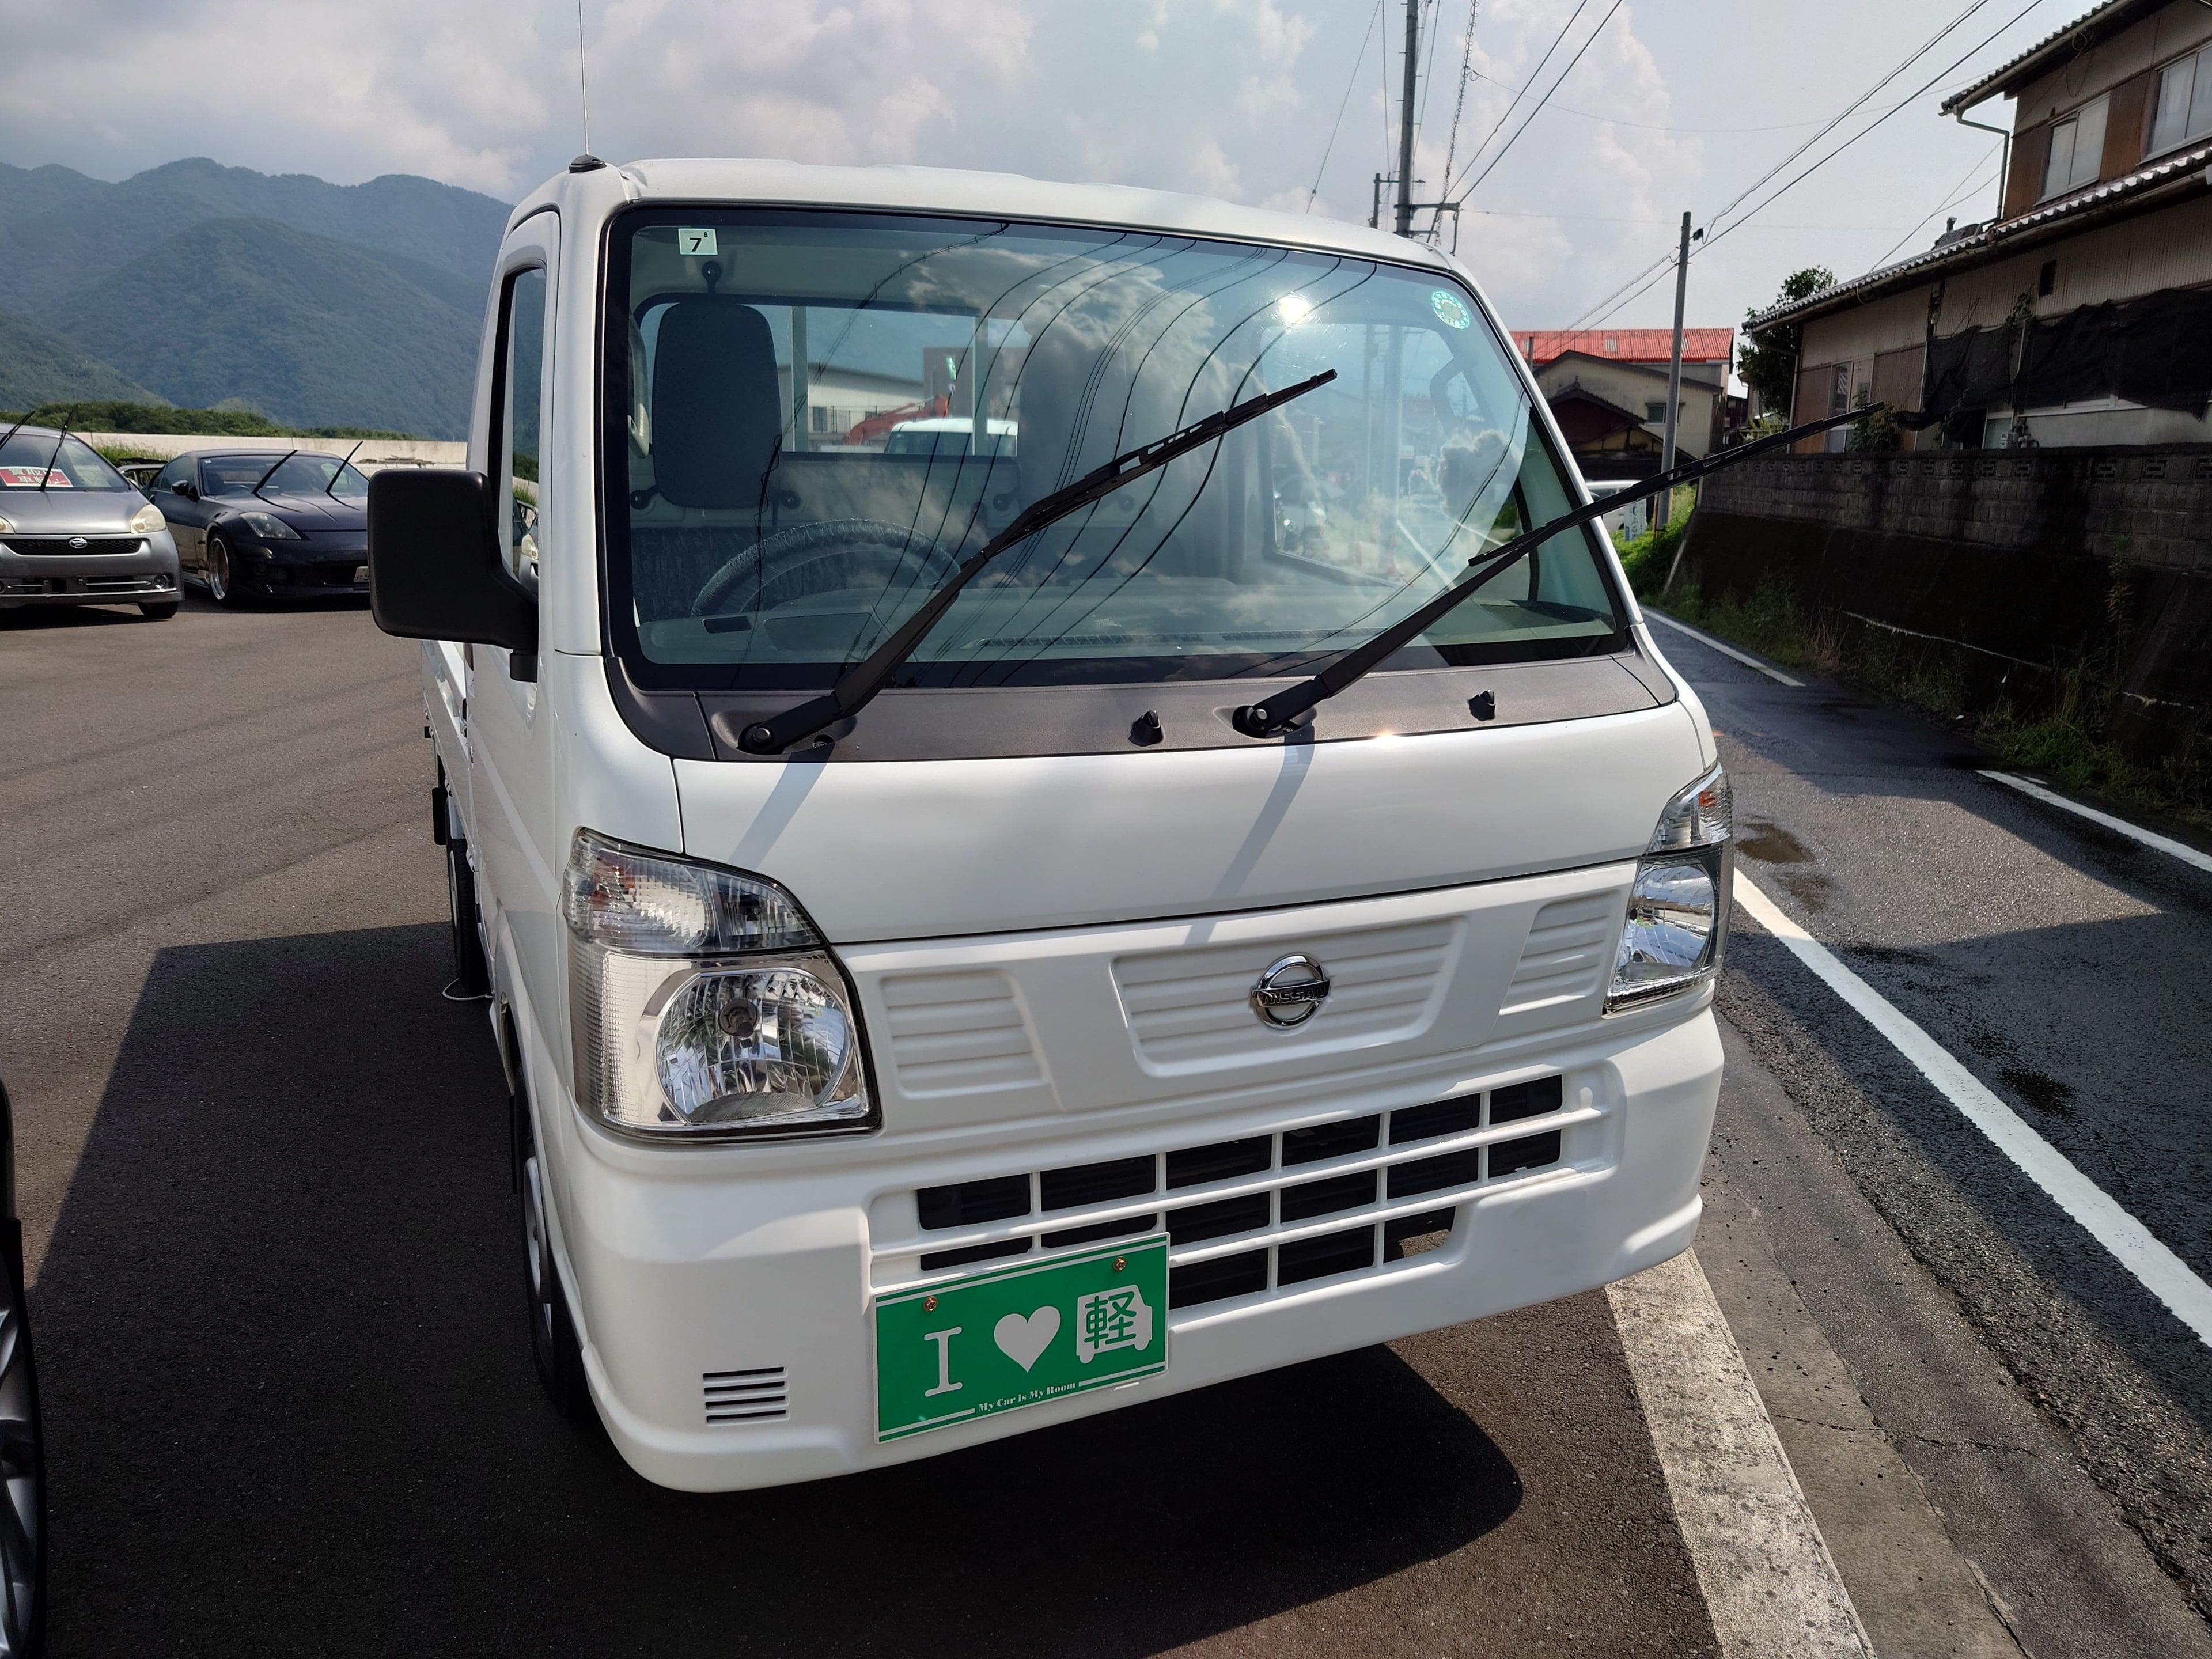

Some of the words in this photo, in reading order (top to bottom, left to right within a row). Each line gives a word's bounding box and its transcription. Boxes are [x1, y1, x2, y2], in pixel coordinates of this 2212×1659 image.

[690, 237, 702, 252] 7
[1262, 986, 1325, 1005] NISSAN
[924, 1326, 963, 1397] I
[1084, 1291, 1137, 1349] 軽
[979, 1402, 995, 1412] My
[997, 1397, 1016, 1407] Car
[1029, 1389, 1045, 1399] My
[1047, 1382, 1075, 1395] Room
